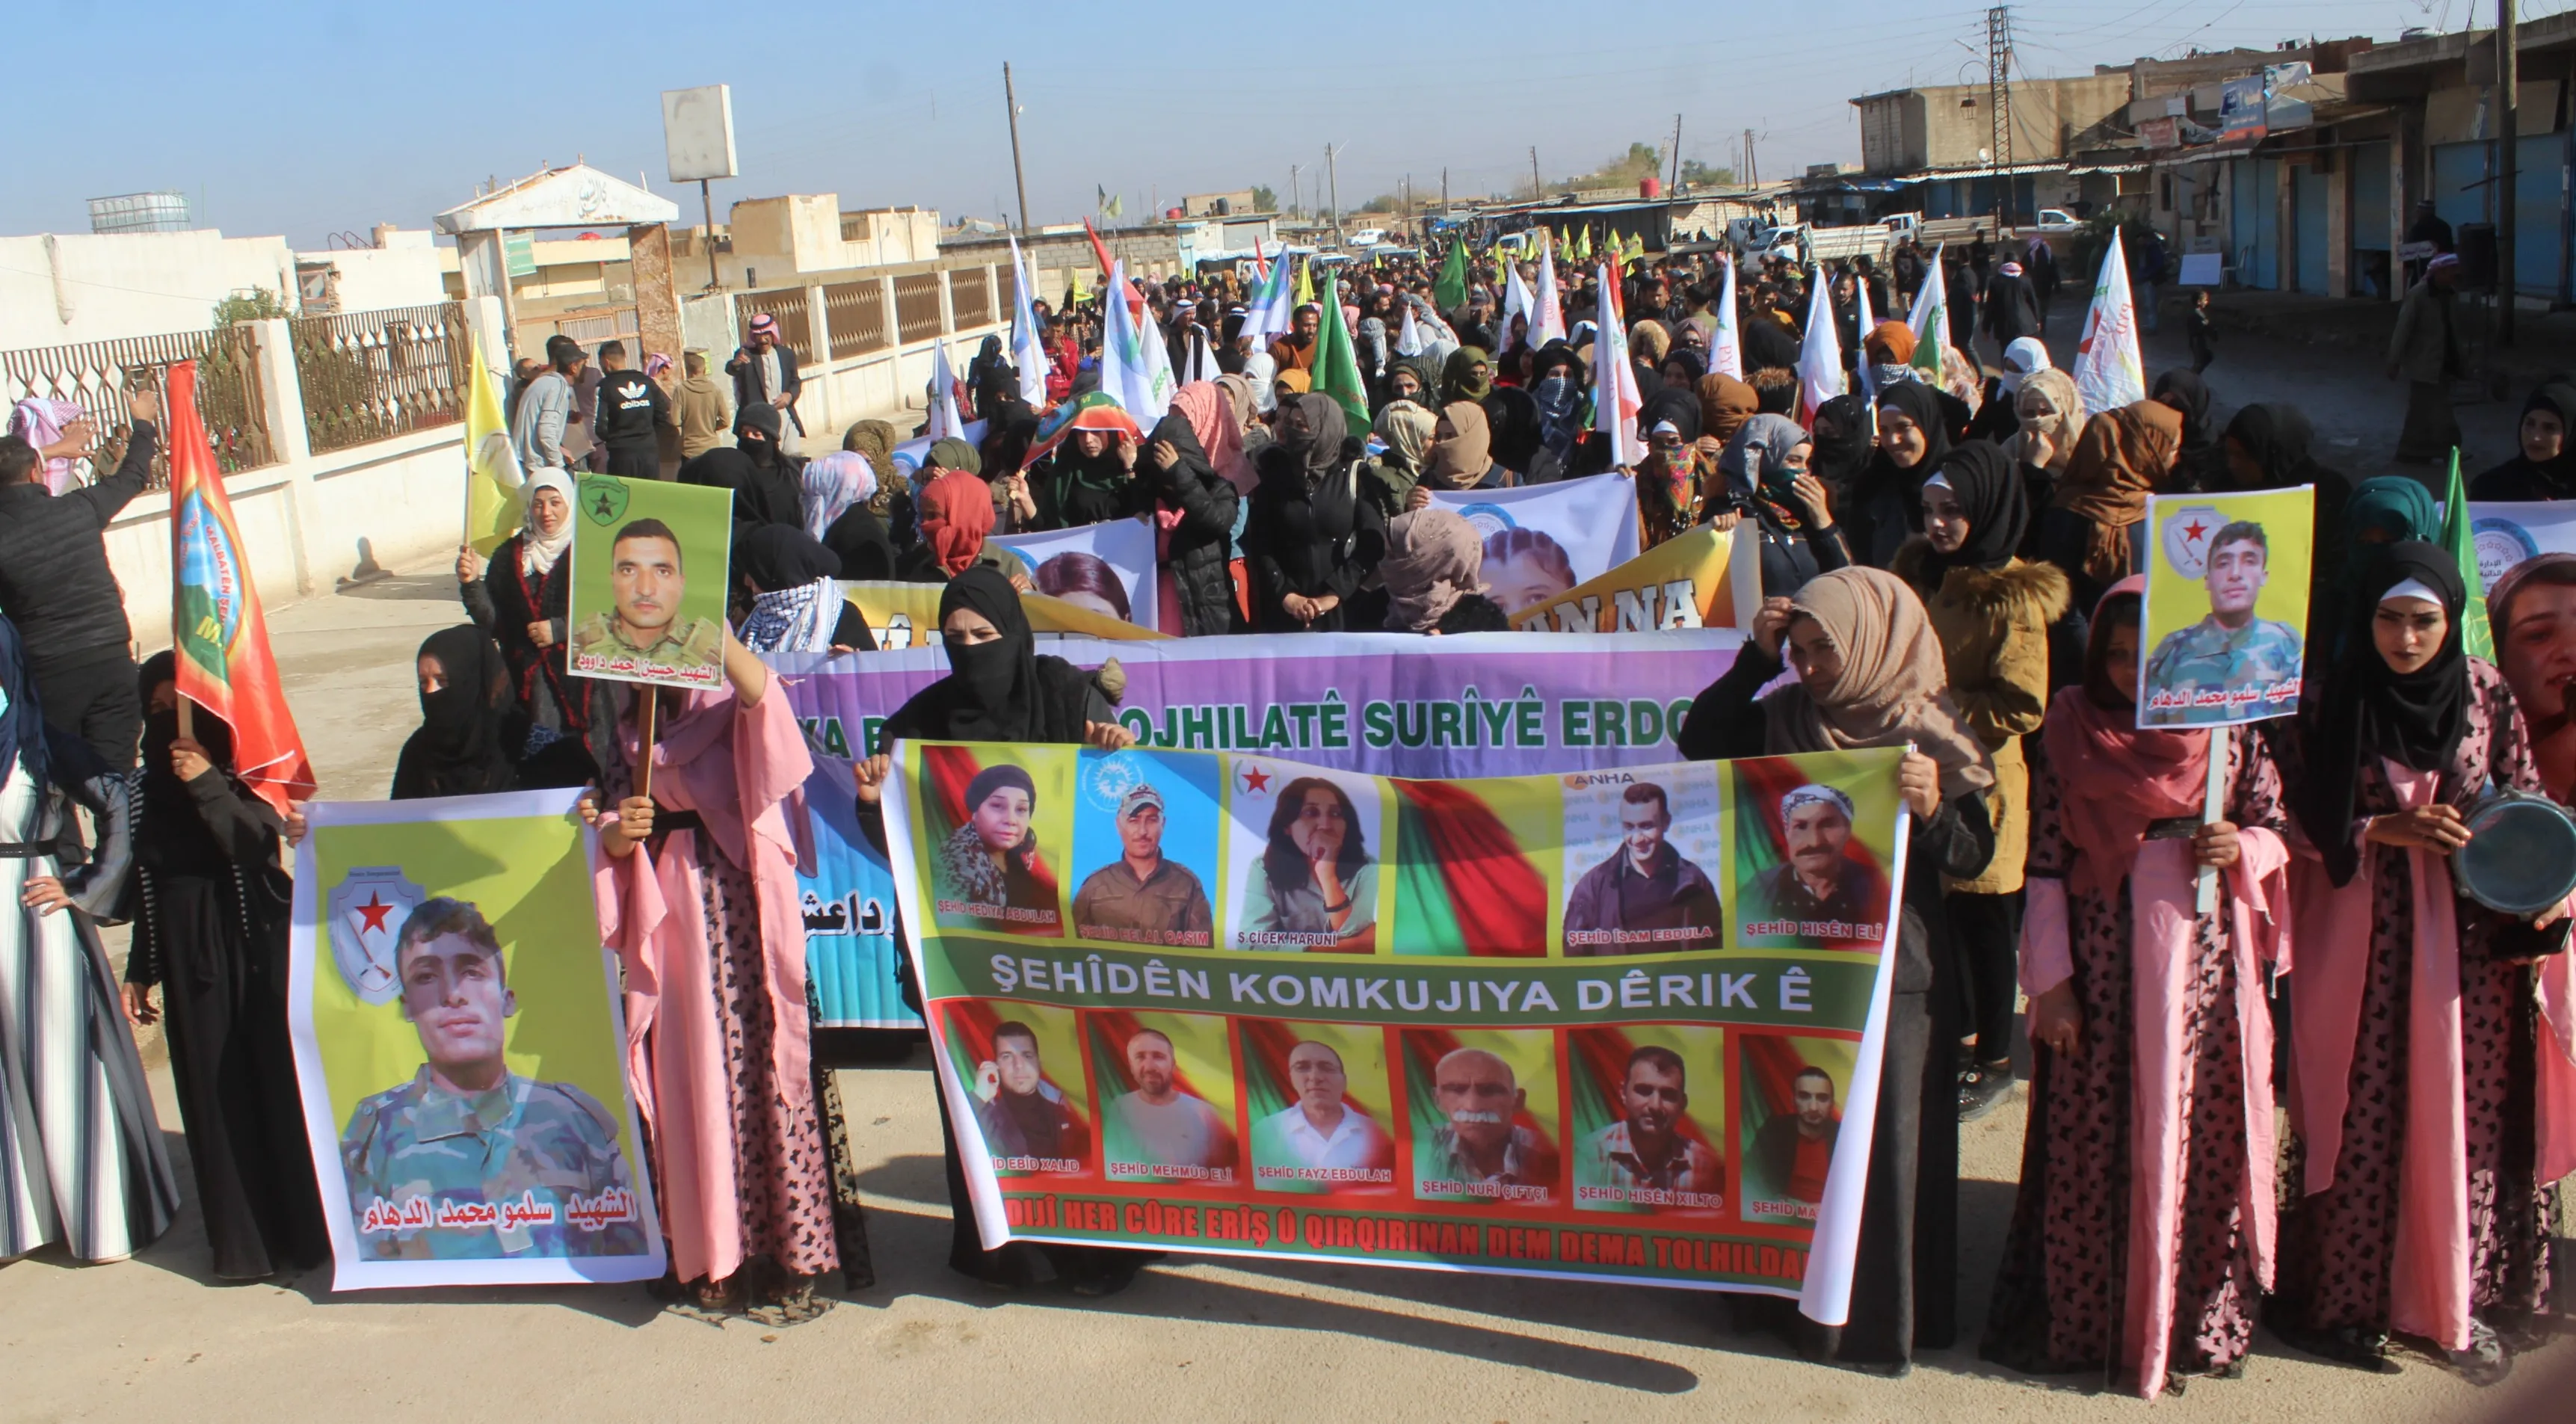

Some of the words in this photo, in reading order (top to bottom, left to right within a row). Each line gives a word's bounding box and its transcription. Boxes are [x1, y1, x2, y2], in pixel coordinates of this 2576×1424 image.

[679, 665, 718, 682] الشهيد
[2149, 688, 2191, 709] الدهام
[2195, 689, 2228, 706] محمد
[1117, 687, 1349, 748] OJHILATÊ
[1364, 684, 1547, 749] SURÎYÊ
[1574, 773, 1635, 785] ANHA
[1005, 905, 1056, 923] ABDULAH
[1119, 928, 1162, 946] HELAL
[1164, 929, 1210, 948] QASIM
[1652, 925, 1713, 942] EBDULA
[990, 953, 1211, 1000] ŞEHÎDÊN
[1229, 973, 1559, 1012] KOMKUJIYA
[1577, 970, 1759, 1011] DÊRIK
[1779, 966, 1813, 1011] Ê
[1040, 1158, 1080, 1173] XALID
[1297, 1167, 1329, 1181] FAYZ
[1331, 1168, 1392, 1183] EBDULAH
[502, 1189, 554, 1230] سلمو
[566, 1186, 637, 1229] الشهيد
[1677, 1193, 1724, 1209] XILTO
[363, 1194, 432, 1232] الدهام
[440, 1198, 497, 1224] محمد
[1796, 1206, 1817, 1220] MA
[1064, 1199, 1118, 1232] HER
[1304, 1213, 1479, 1256] QIRQIRINAN
[1486, 1224, 1552, 1261] DEM
[1558, 1228, 1648, 1267] DEMA
[1652, 1236, 1808, 1281] TOLHILDA
